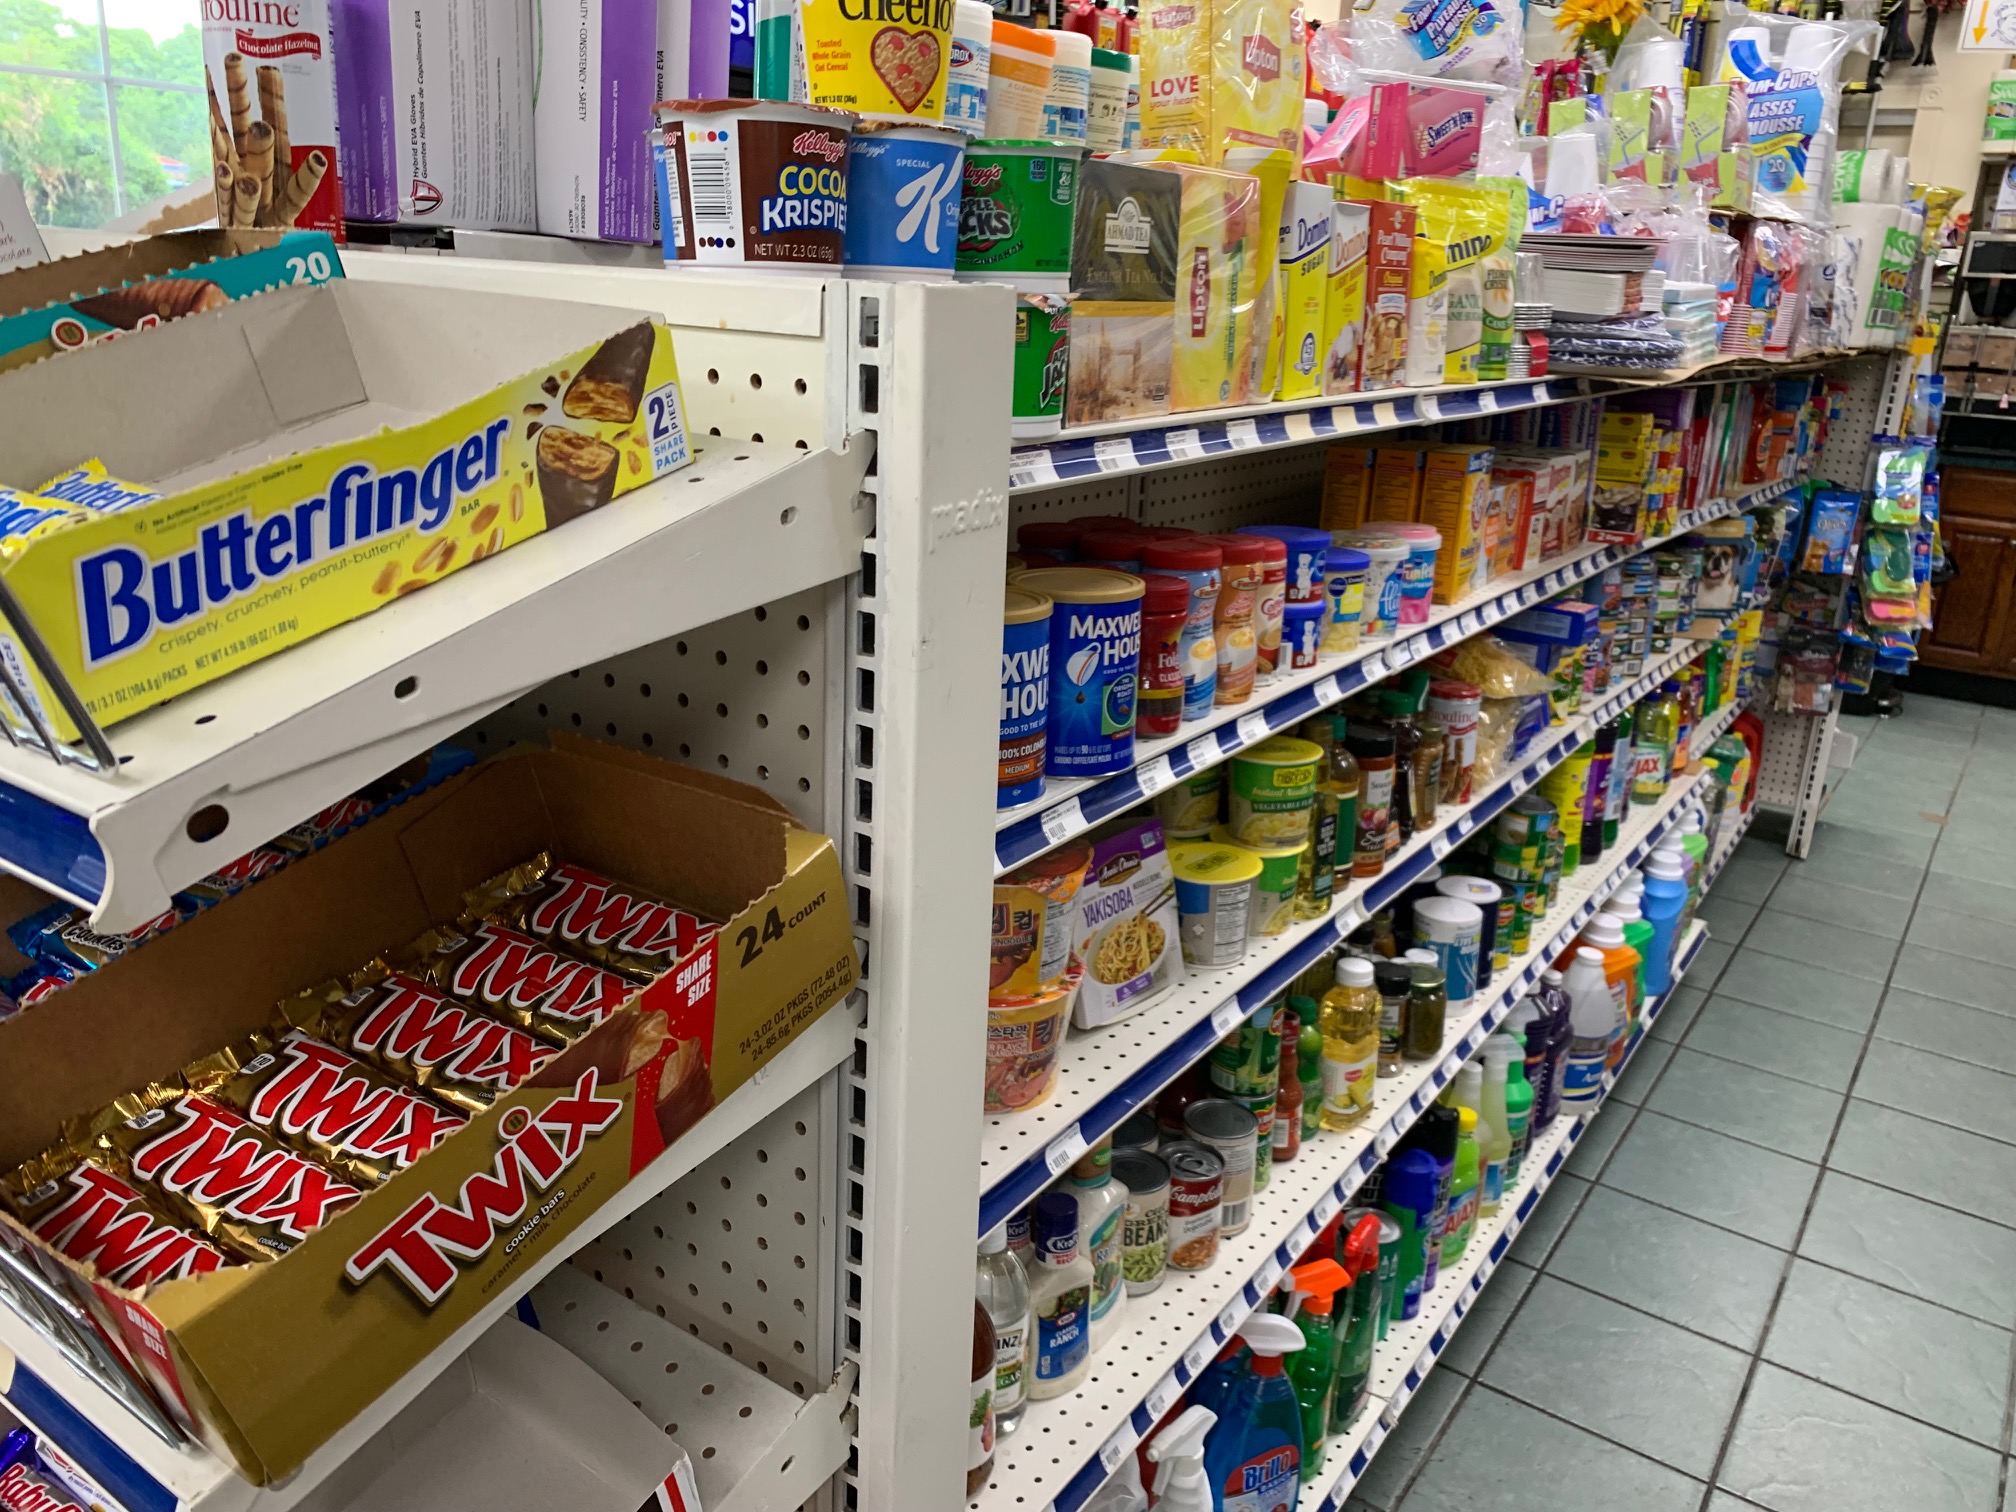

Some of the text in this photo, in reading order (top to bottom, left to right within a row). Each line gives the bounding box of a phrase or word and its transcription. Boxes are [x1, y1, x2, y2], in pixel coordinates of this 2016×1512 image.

[238, 39, 283, 55] Chocolate
[816, 39, 842, 48] Toasted
[831, 50, 851, 59] Grain
[1246, 41, 1279, 72] Lipton
[578, 28, 588, 122] CONSISTENCY SAFETY
[656, 50, 664, 70] EVA
[826, 62, 848, 71] Cereal
[1151, 75, 1199, 98] LOVE
[410, 127, 418, 146] EVA
[793, 130, 847, 160] Kellogg's
[412, 151, 420, 178] Hybrid
[419, 140, 428, 178] Guantes
[897, 158, 931, 169] SPECIAL
[1769, 158, 1786, 173] 20
[780, 166, 847, 202] COCOA
[895, 150, 965, 254] K
[1107, 223, 1149, 242] AHMAD TEA
[755, 243, 772, 256] NET
[775, 244, 790, 257] WT
[792, 244, 806, 257] 2.3
[807, 246, 817, 258] OZ
[1301, 250, 1325, 277] SUGAR
[286, 251, 331, 285] 20
[1192, 255, 1208, 330] Lipton
[649, 396, 669, 440] 2
[665, 390, 679, 430] PIECE
[654, 433, 684, 456] SHARE
[656, 446, 686, 470] PACK
[461, 498, 481, 517] BAR
[80, 418, 510, 663] Butterfinger
[159, 617, 223, 654] crispety,
[226, 583, 297, 623] crunchety,
[195, 656, 209, 670] NET
[209, 651, 222, 667] WT
[101, 692, 115, 708] 3.7
[115, 688, 128, 703] OZ
[162, 666, 188, 684] PACKS
[1004, 763, 1030, 775] MEDIUM
[1083, 886, 1135, 928] YAKISOBA
[735, 890, 827, 969] 24 COUNT
[675, 948, 713, 995] SHARE
[687, 972, 712, 1008] SIZE
[739, 954, 850, 1055] 24-3.02 OZ PKGS (72.48 OZ)
[751, 970, 852, 1062] 24-85.6g PKGS (2054.4g)
[481, 1170, 598, 1295] caramel milk chocolate
[504, 1187, 566, 1255] cookie bars
[125, 1305, 161, 1343] SHARE
[1049, 1328, 1080, 1349] RANCH
[143, 1332, 168, 1360] SIZE
[1243, 1451, 1291, 1493] Brillo
